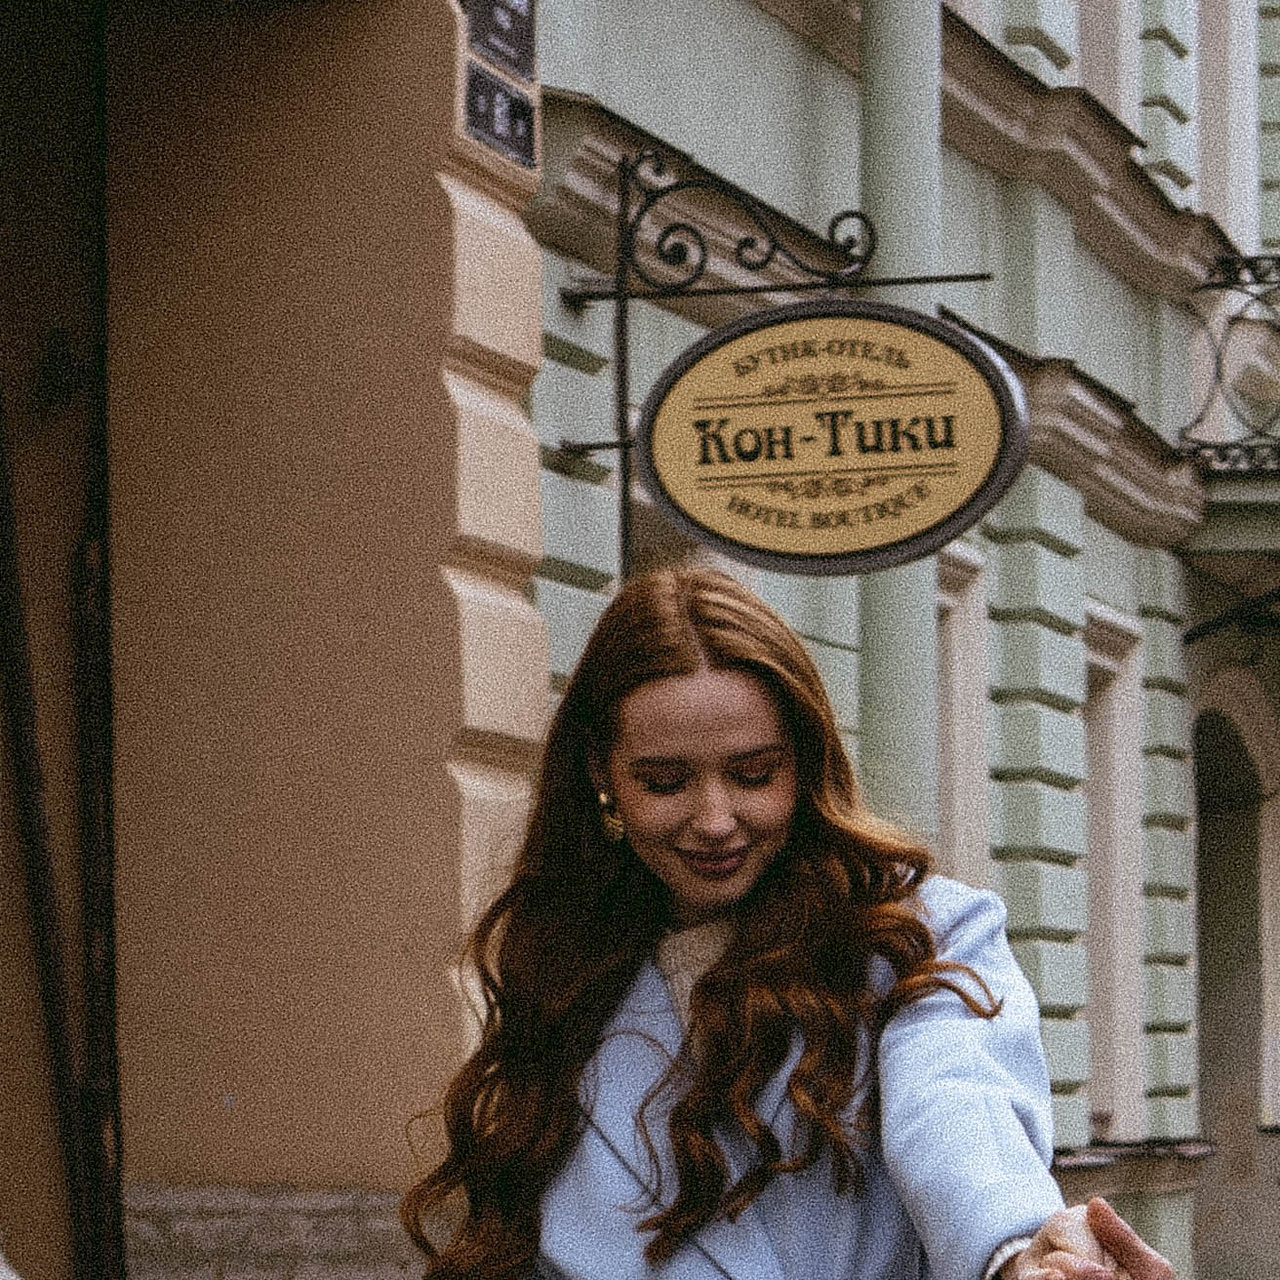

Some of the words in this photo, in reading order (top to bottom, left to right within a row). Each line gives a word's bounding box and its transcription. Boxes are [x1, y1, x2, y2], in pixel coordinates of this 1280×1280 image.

[732, 339, 911, 377] БУТИК-ОТЕЛЬ
[693, 409, 957, 467] Кон-Тики
[726, 495, 800, 529] HOTEL
